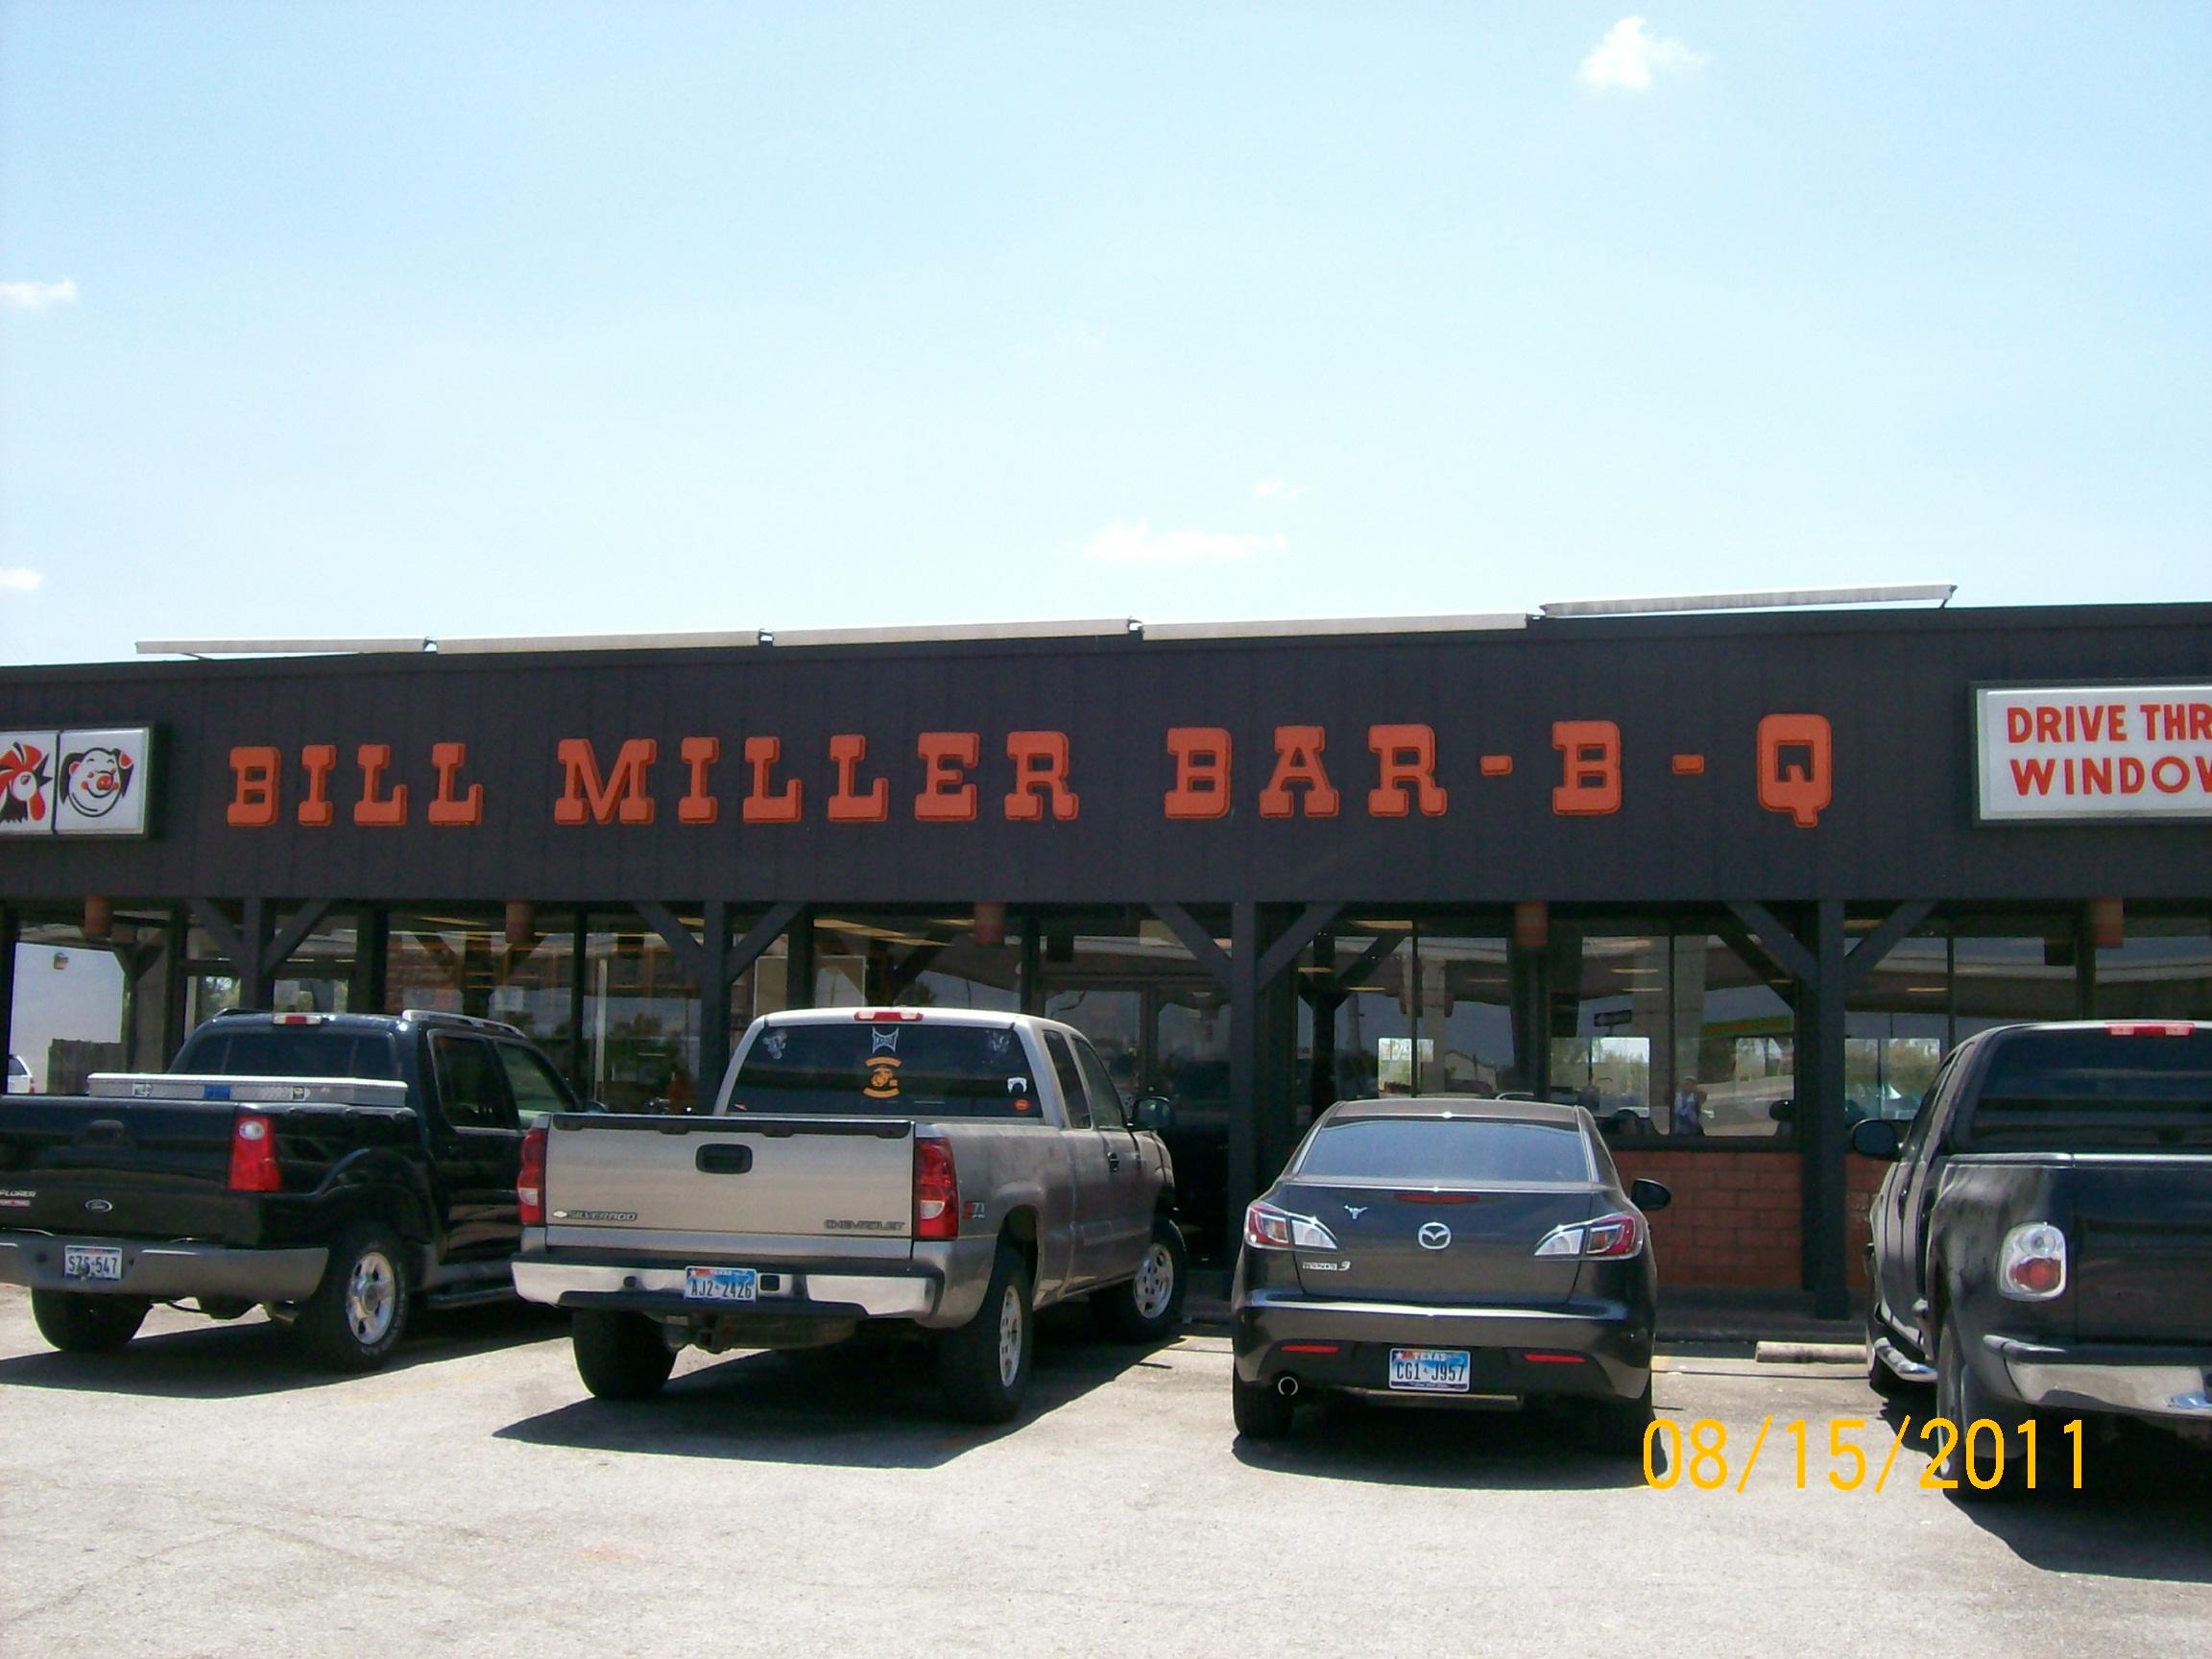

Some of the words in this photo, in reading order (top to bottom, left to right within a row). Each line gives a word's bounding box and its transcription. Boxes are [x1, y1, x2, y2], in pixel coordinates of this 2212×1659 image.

[2007, 705, 2128, 743] DRIVE
[2140, 703, 2212, 741] THR
[228, 742, 483, 827] BILL
[554, 731, 1079, 824] MILLER
[1413, 1352, 1447, 1361] TEXAS
